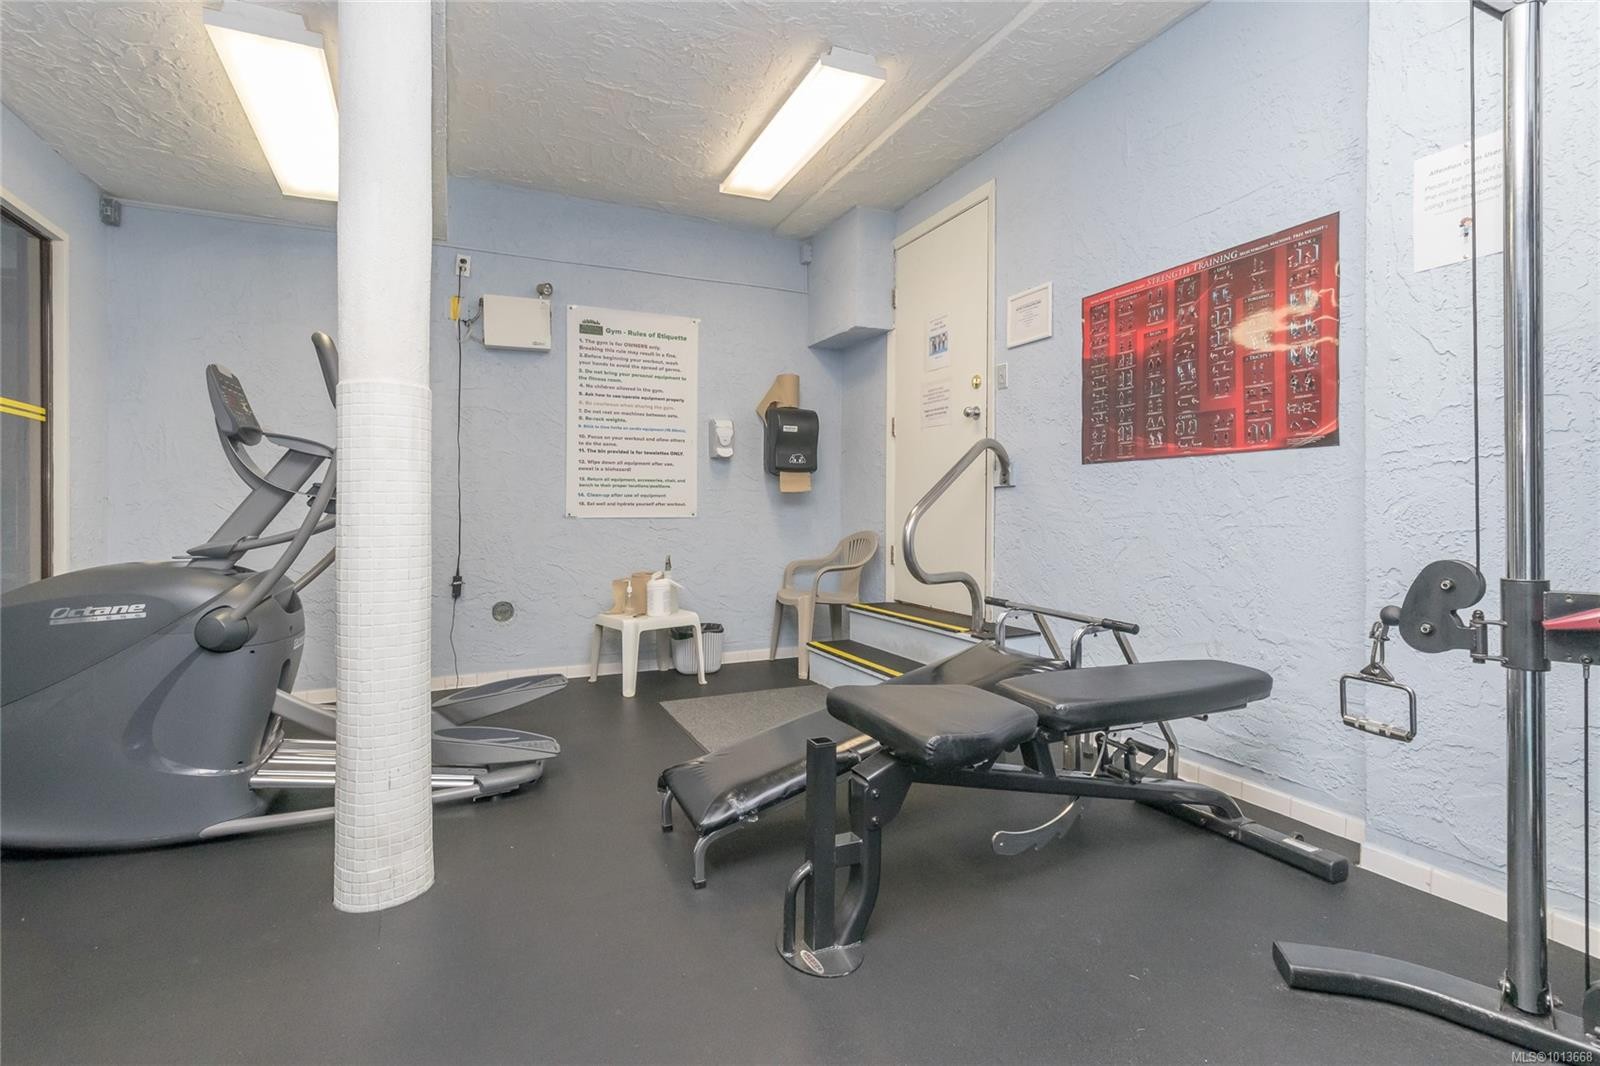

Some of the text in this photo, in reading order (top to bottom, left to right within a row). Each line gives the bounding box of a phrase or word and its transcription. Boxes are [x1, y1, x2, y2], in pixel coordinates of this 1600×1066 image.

[1464, 156, 1482, 165] Gm
[1146, 249, 1238, 286] STRENGTH TRAINING
[657, 333, 687, 342] Etiquette
[49, 604, 146, 619] Octane
